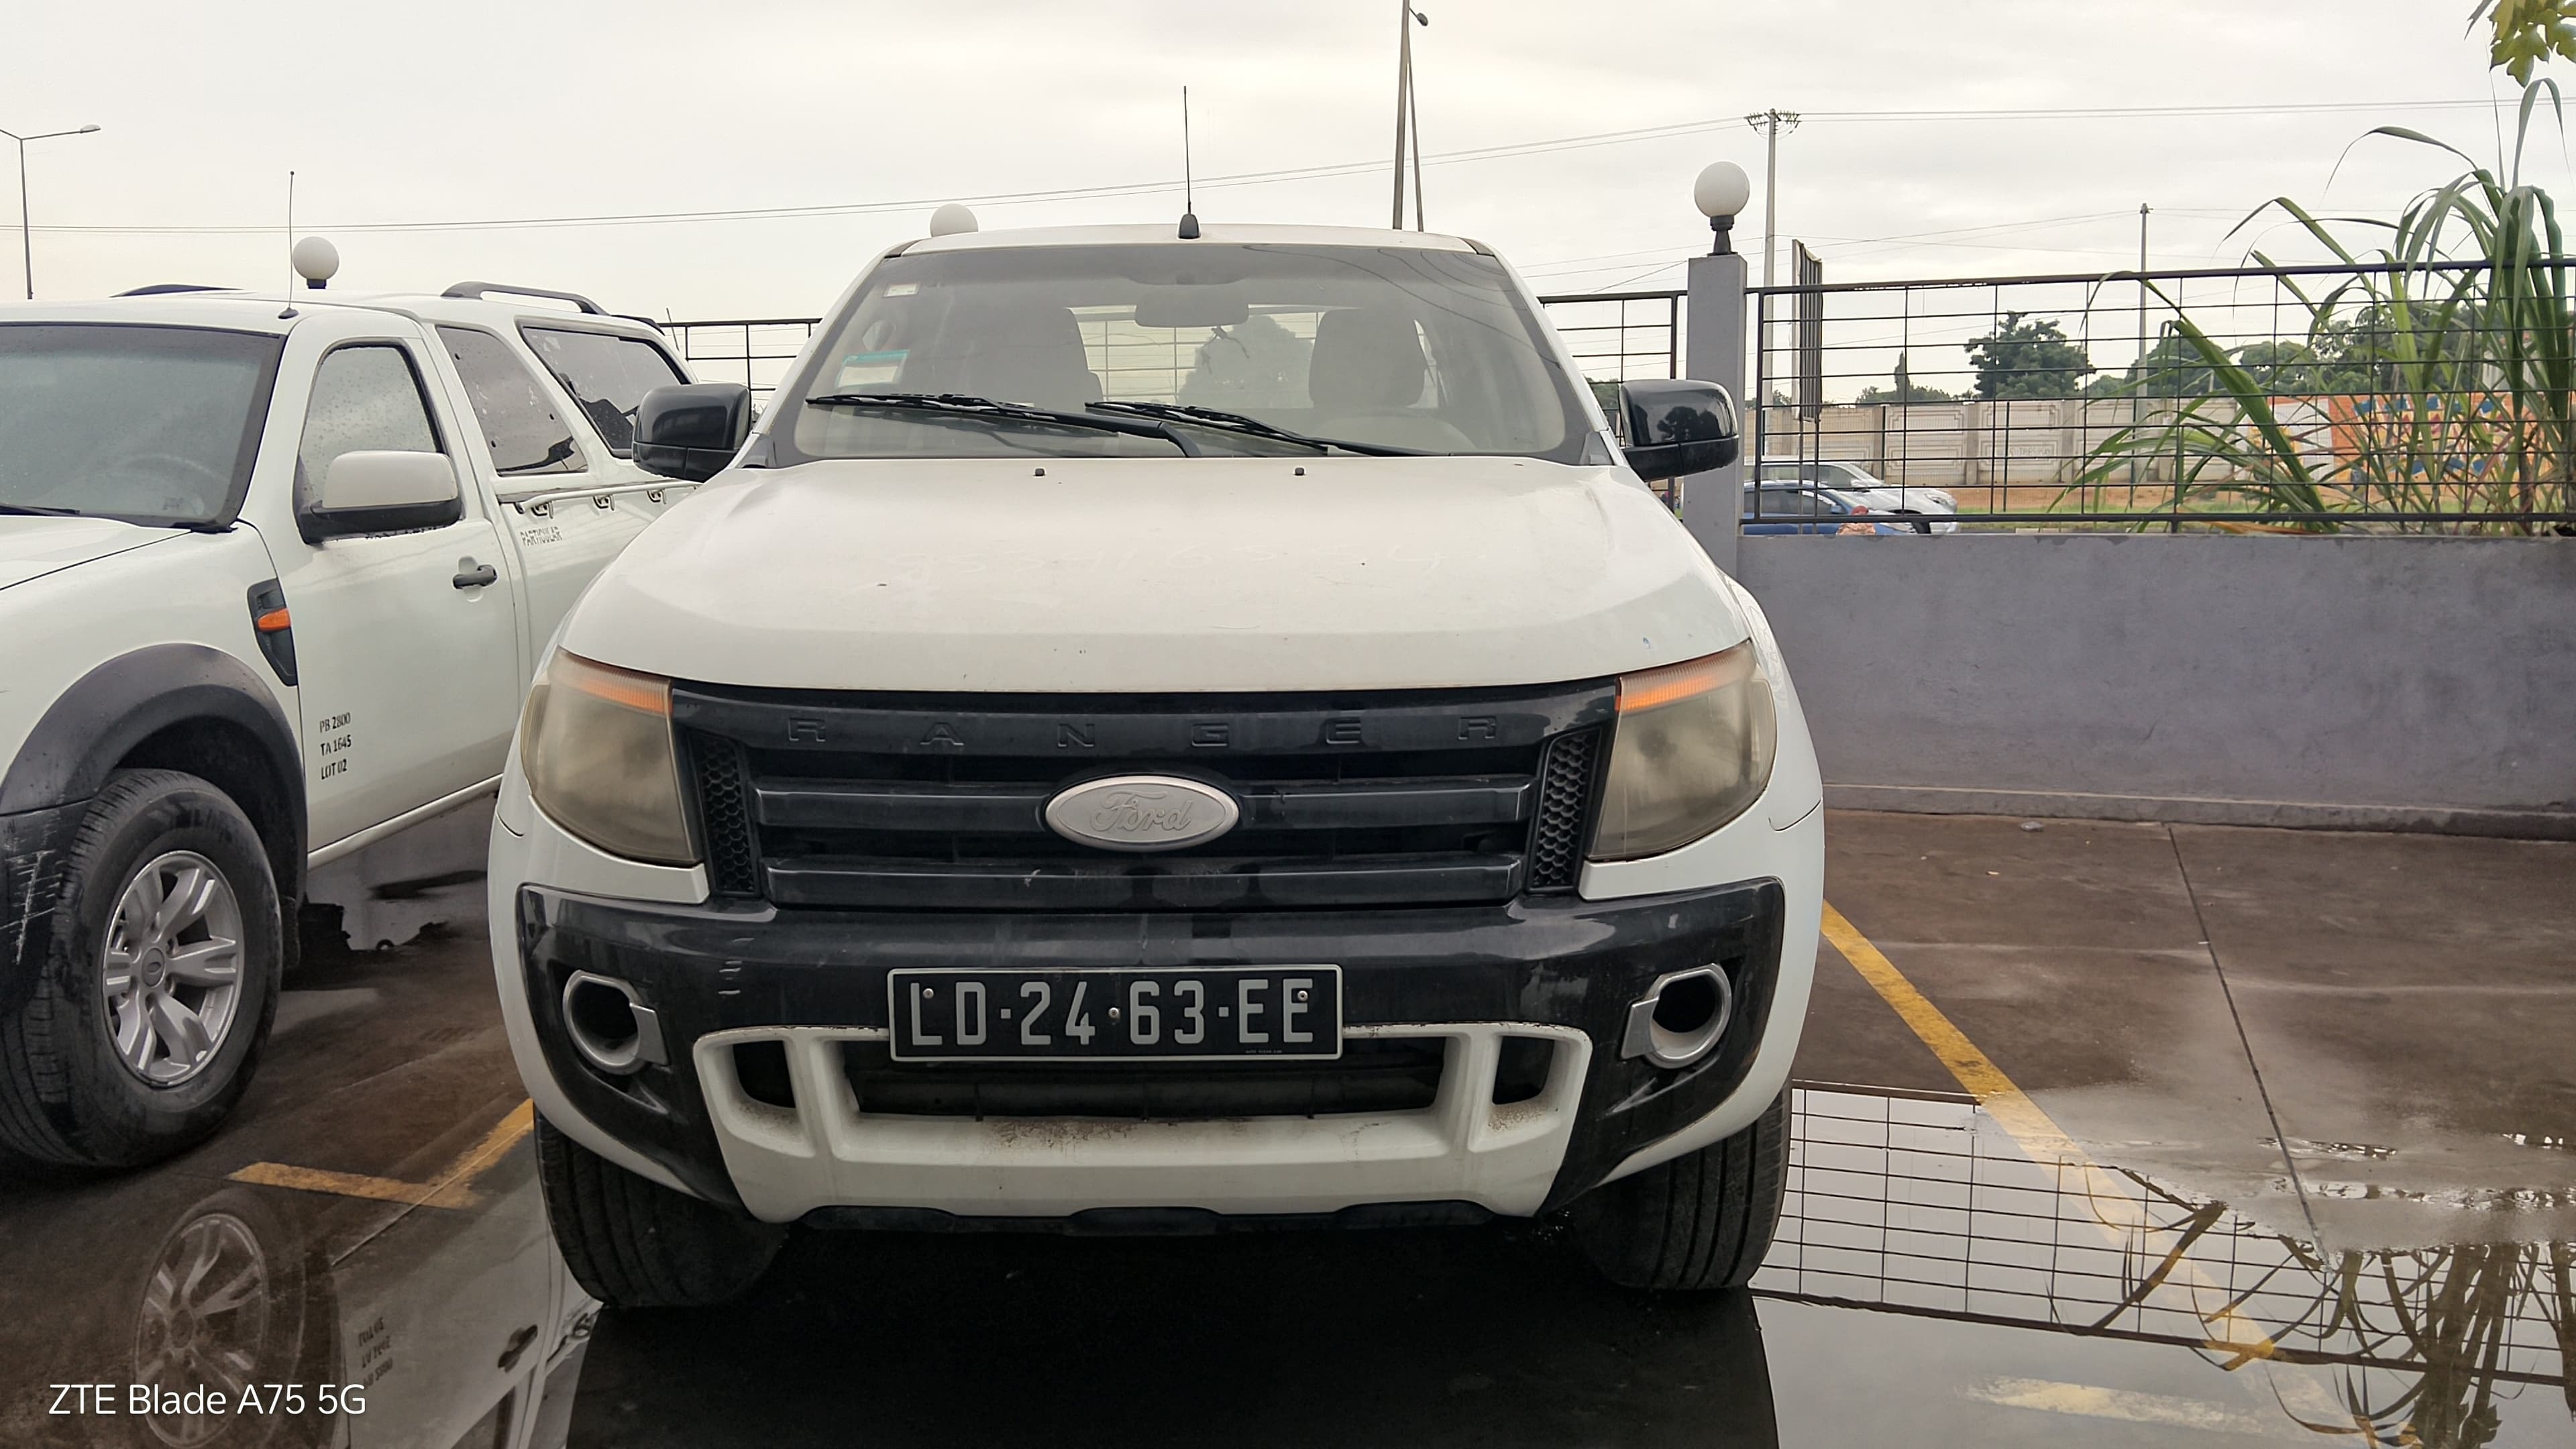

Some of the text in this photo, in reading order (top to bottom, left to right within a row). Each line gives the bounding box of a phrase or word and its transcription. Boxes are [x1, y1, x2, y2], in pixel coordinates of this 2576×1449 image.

[319, 712, 351, 733] PB 2800
[788, 717, 1497, 747] RANGER
[321, 734, 352, 756] TA 1645
[321, 758, 347, 780] LOT 02
[1090, 789, 1193, 832] Ford
